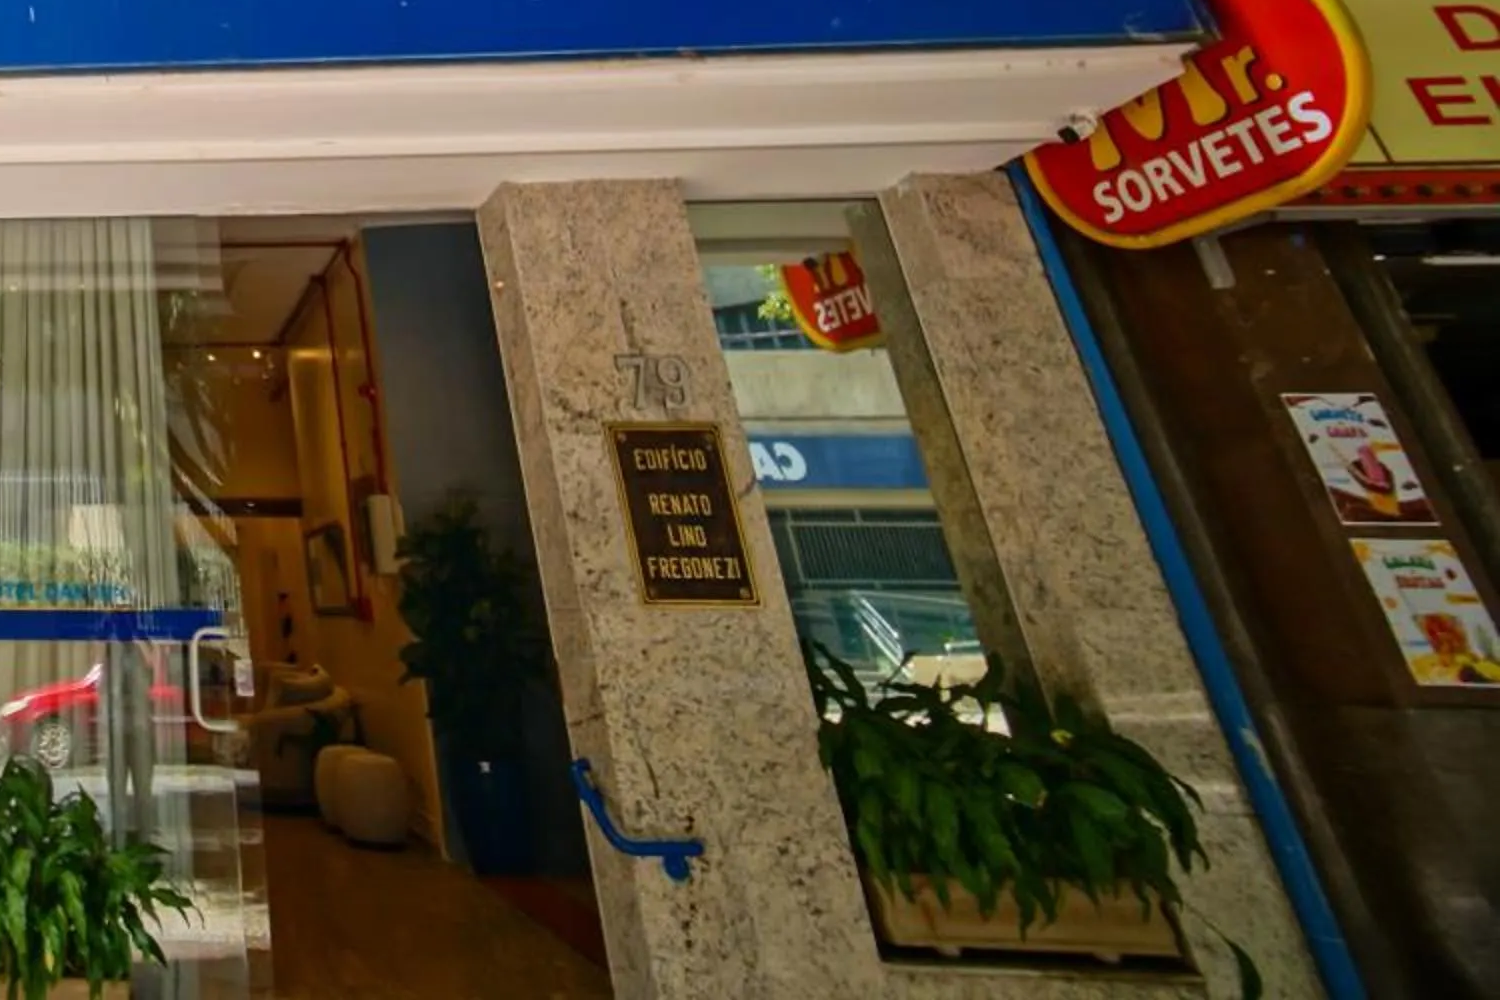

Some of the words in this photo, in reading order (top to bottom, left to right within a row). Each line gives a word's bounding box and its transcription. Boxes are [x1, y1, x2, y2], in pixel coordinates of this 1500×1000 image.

[1092, 90, 1333, 224] SORVETES
[614, 354, 691, 411] 79
[633, 444, 707, 470] EDIFÍCIO
[648, 493, 712, 516] RENATO
[667, 525, 707, 547] LINO
[647, 556, 741, 580] FREGONEZI
